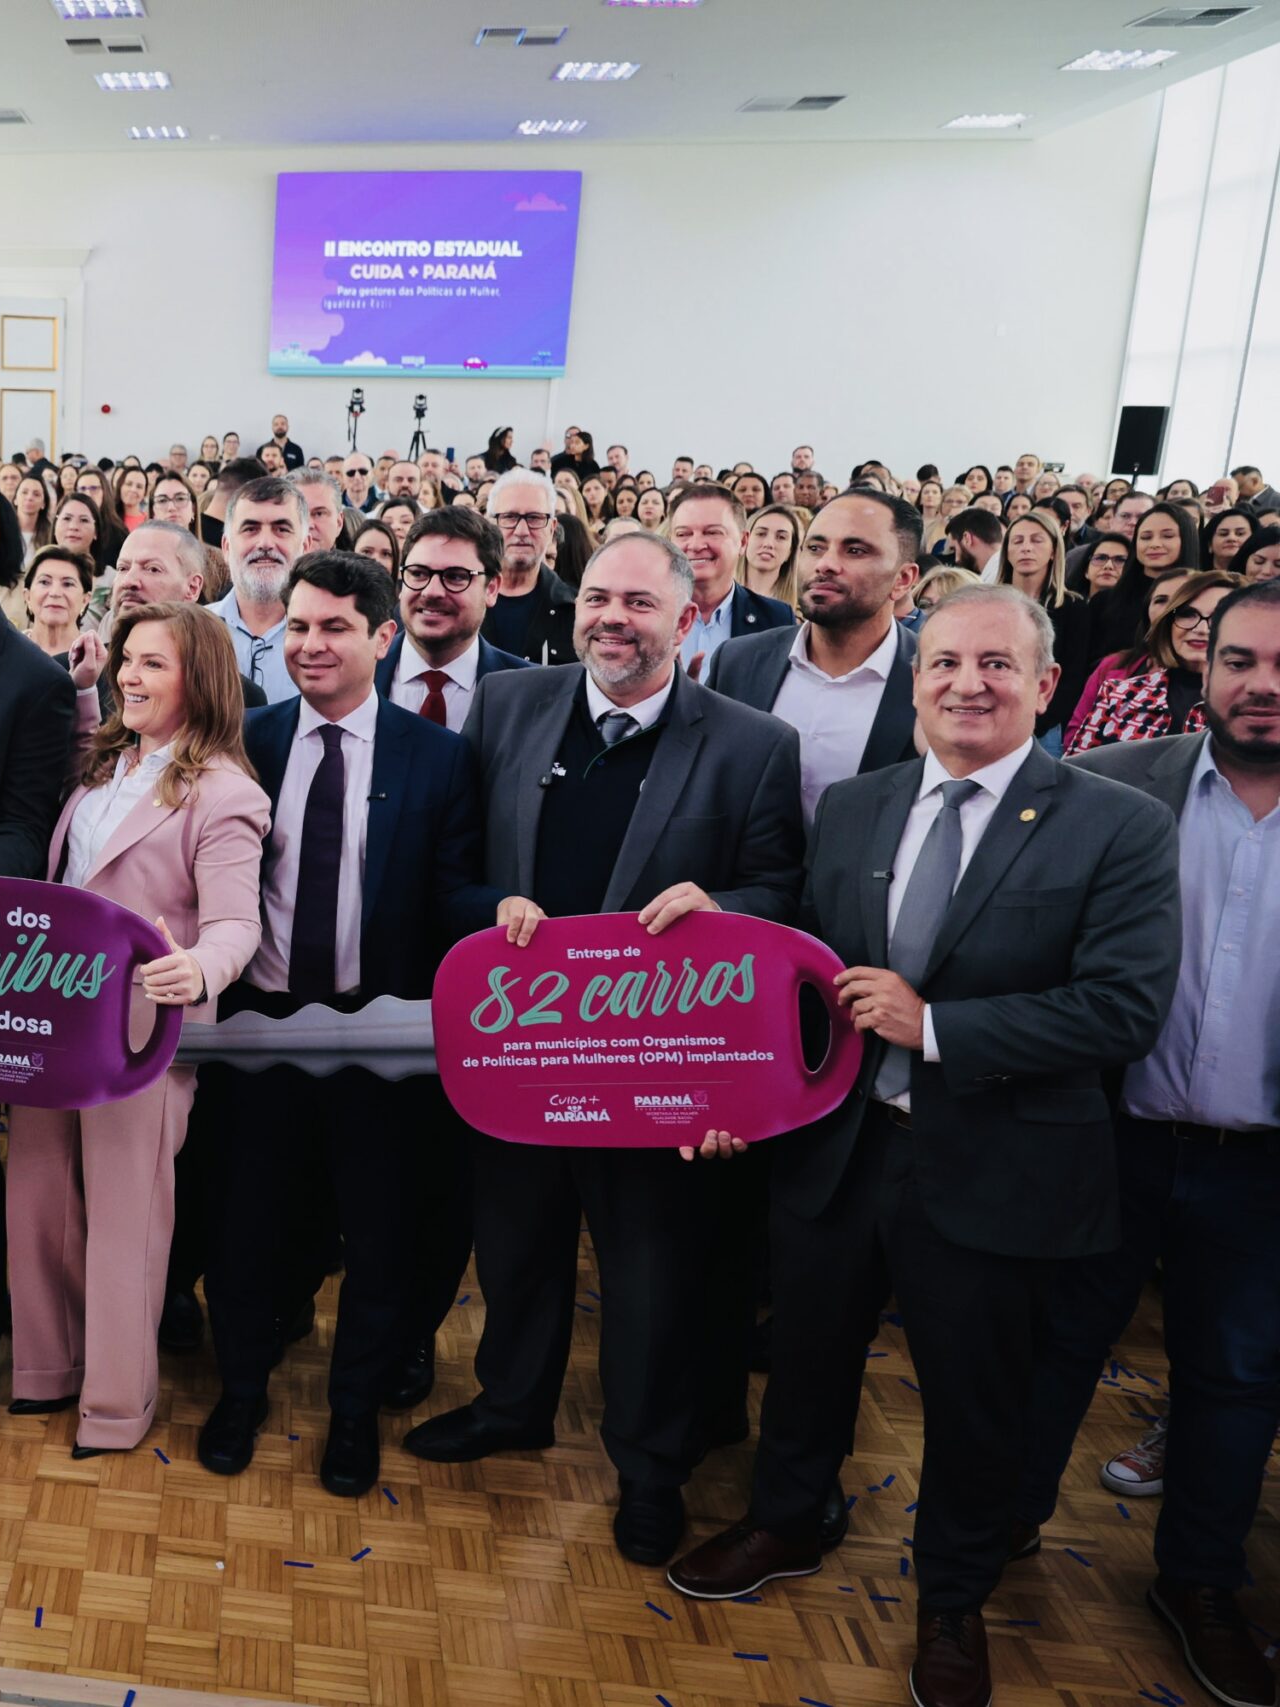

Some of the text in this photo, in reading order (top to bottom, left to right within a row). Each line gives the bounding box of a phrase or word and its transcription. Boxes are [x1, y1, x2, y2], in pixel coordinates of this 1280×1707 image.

[325, 241, 522, 257] II ENCONTRO ESTADUAL
[350, 261, 496, 279] CUIDA + PARANÁ
[337, 286, 357, 296] Para
[359, 287, 396, 297] gestores
[399, 287, 414, 296] das
[456, 286, 467, 297] da
[7, 907, 50, 929] dos
[567, 946, 640, 960] Entrega de
[470, 953, 756, 1033] 82 carros
[504, 1035, 725, 1052] para municípios com Organismos
[463, 1050, 774, 1067] de Políticas para Mulheres (OPM) implantados
[550, 1094, 586, 1106] CUIDA
[634, 1094, 693, 1106] PARANÁ
[545, 1108, 610, 1122] PARANÁ
